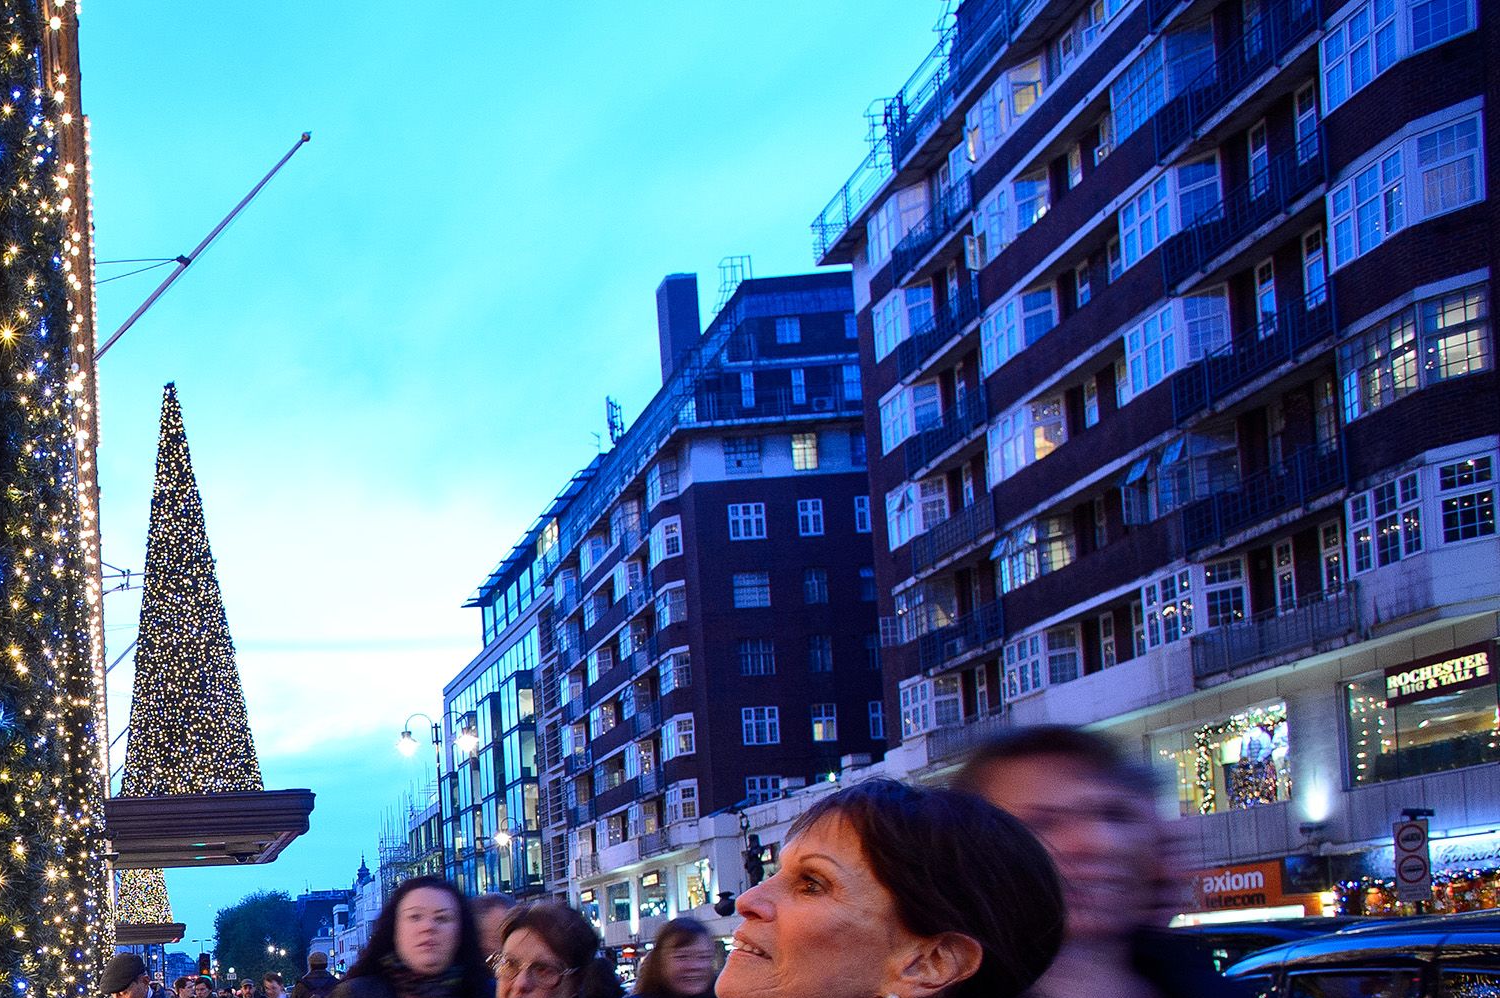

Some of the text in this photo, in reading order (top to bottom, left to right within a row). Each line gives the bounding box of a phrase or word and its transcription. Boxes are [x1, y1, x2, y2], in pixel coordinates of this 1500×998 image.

[1386, 652, 1488, 689] ROCHESTER
[1401, 669, 1473, 695] BIG & TALL
[1203, 870, 1264, 894] axiom
[1205, 892, 1266, 909] telecom
